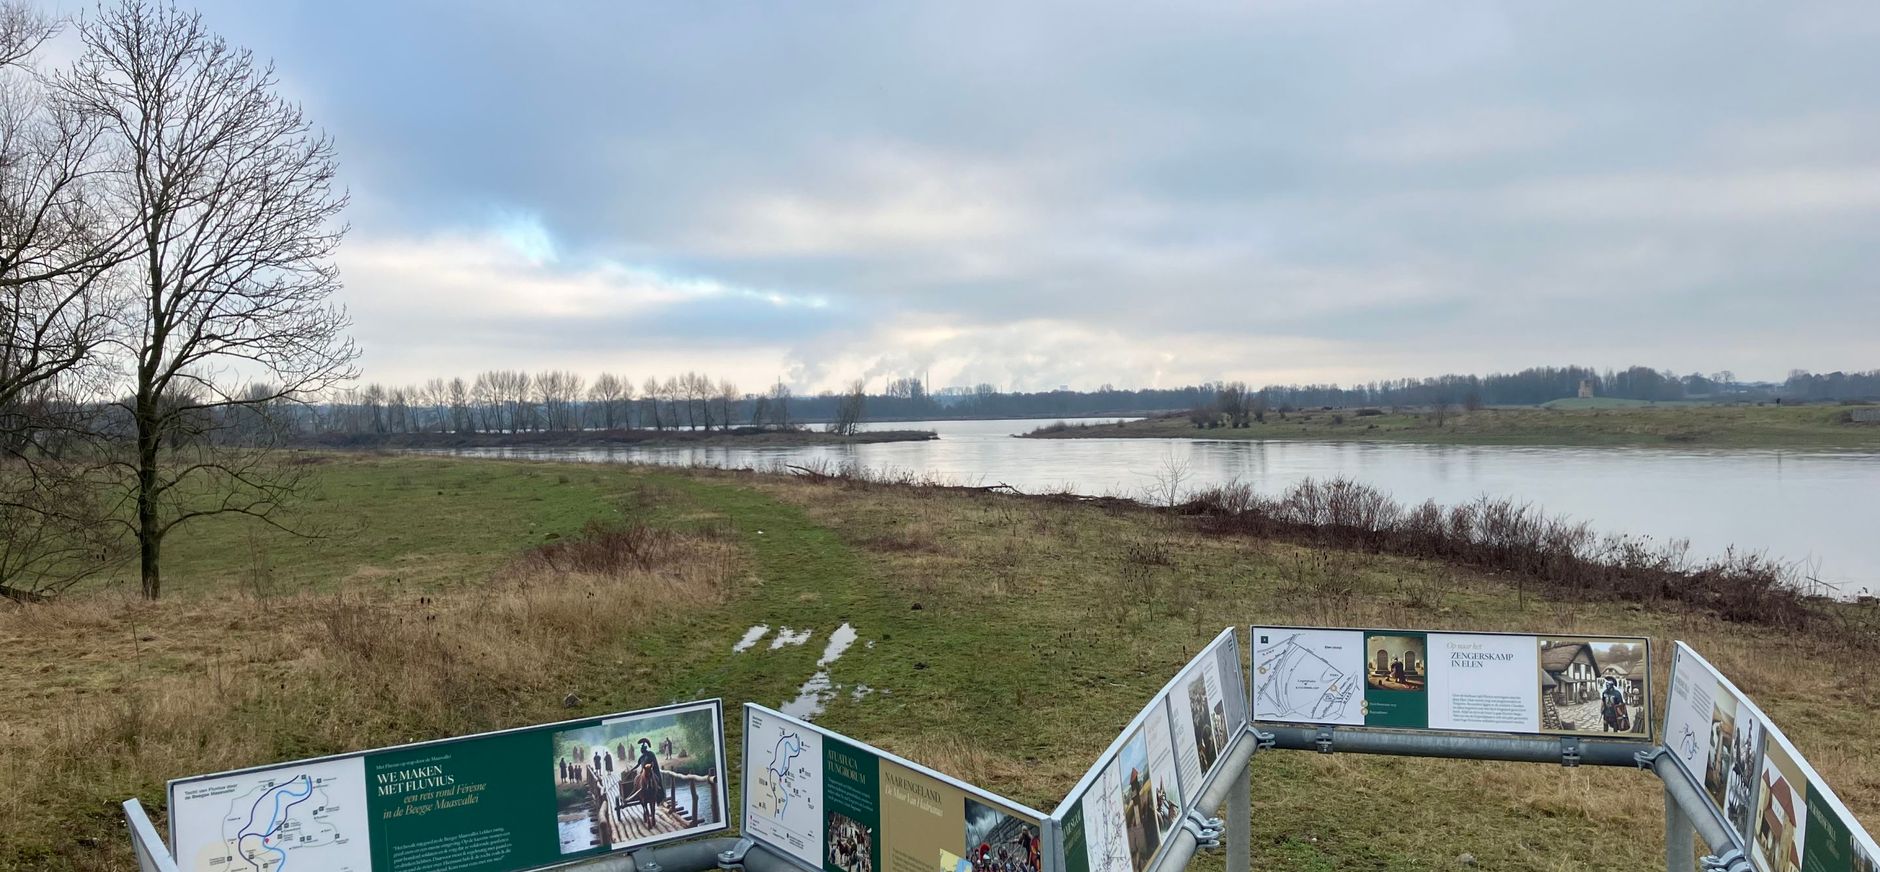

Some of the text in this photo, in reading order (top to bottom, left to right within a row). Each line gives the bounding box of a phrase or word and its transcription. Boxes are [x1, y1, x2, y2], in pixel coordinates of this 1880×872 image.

[1446, 642, 1456, 651] Op
[1472, 642, 1482, 650] het
[1451, 652, 1514, 660] ZENGERSKAMP
[1452, 660, 1483, 668] IN ELEN
[377, 764, 443, 784] WE MAKEN
[884, 770, 903, 788] NAAR
[378, 774, 455, 797] MET FLUVIUS
[403, 793, 418, 804] een
[419, 789, 434, 801] reis
[435, 786, 455, 799] rond
[383, 793, 479, 820] in de Beegse Maasvallei
